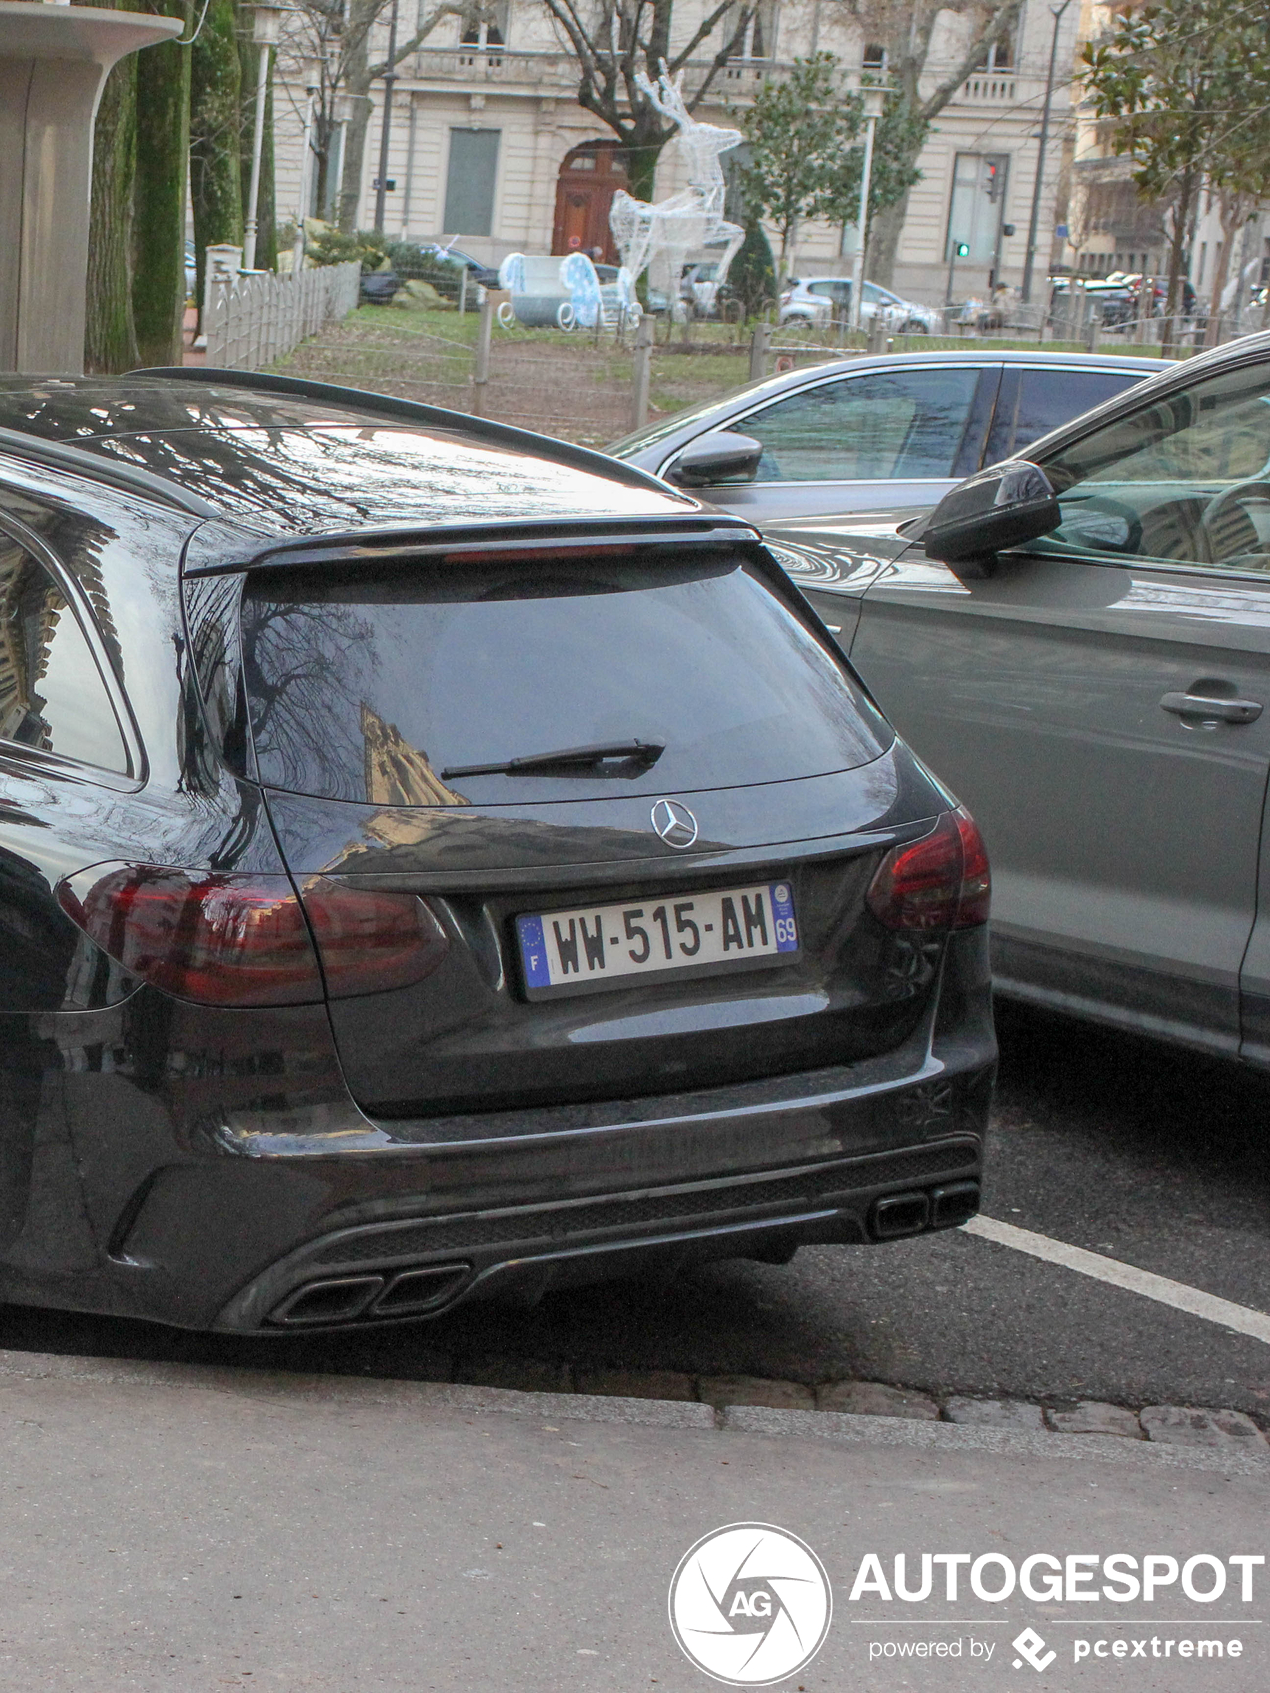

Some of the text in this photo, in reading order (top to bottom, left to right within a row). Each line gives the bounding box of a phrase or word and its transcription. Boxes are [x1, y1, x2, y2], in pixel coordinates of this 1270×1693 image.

[552, 893, 769, 975] WW-515-AM
[776, 917, 797, 943] 69
[530, 955, 539, 971] F
